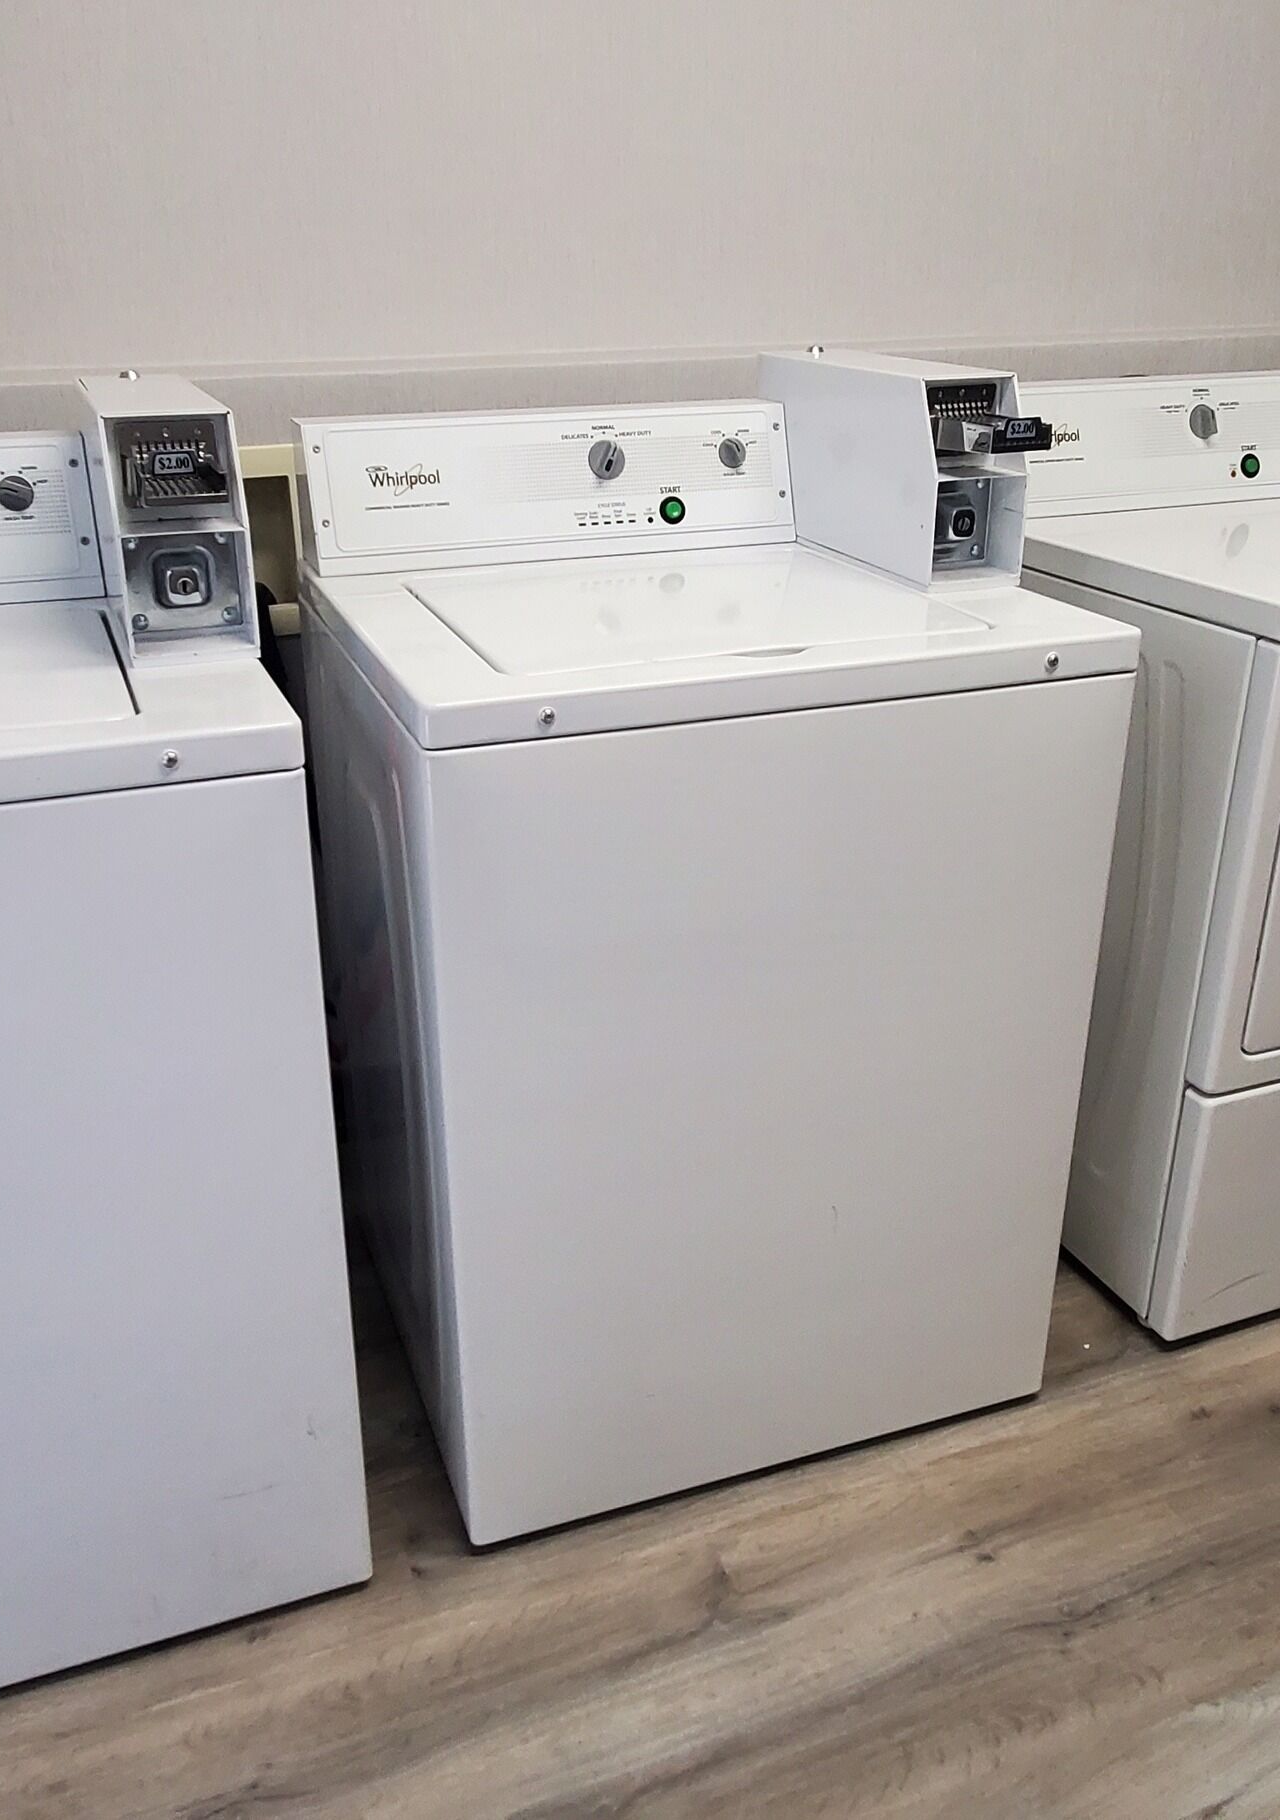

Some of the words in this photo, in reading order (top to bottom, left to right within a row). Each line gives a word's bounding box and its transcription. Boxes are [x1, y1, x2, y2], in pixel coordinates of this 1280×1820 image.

[1010, 422, 1034, 435] $2.00
[1051, 428, 1080, 446] lpool
[158, 457, 190, 470] $2.00
[368, 468, 440, 490] Whirlpool
[659, 486, 681, 494] START
